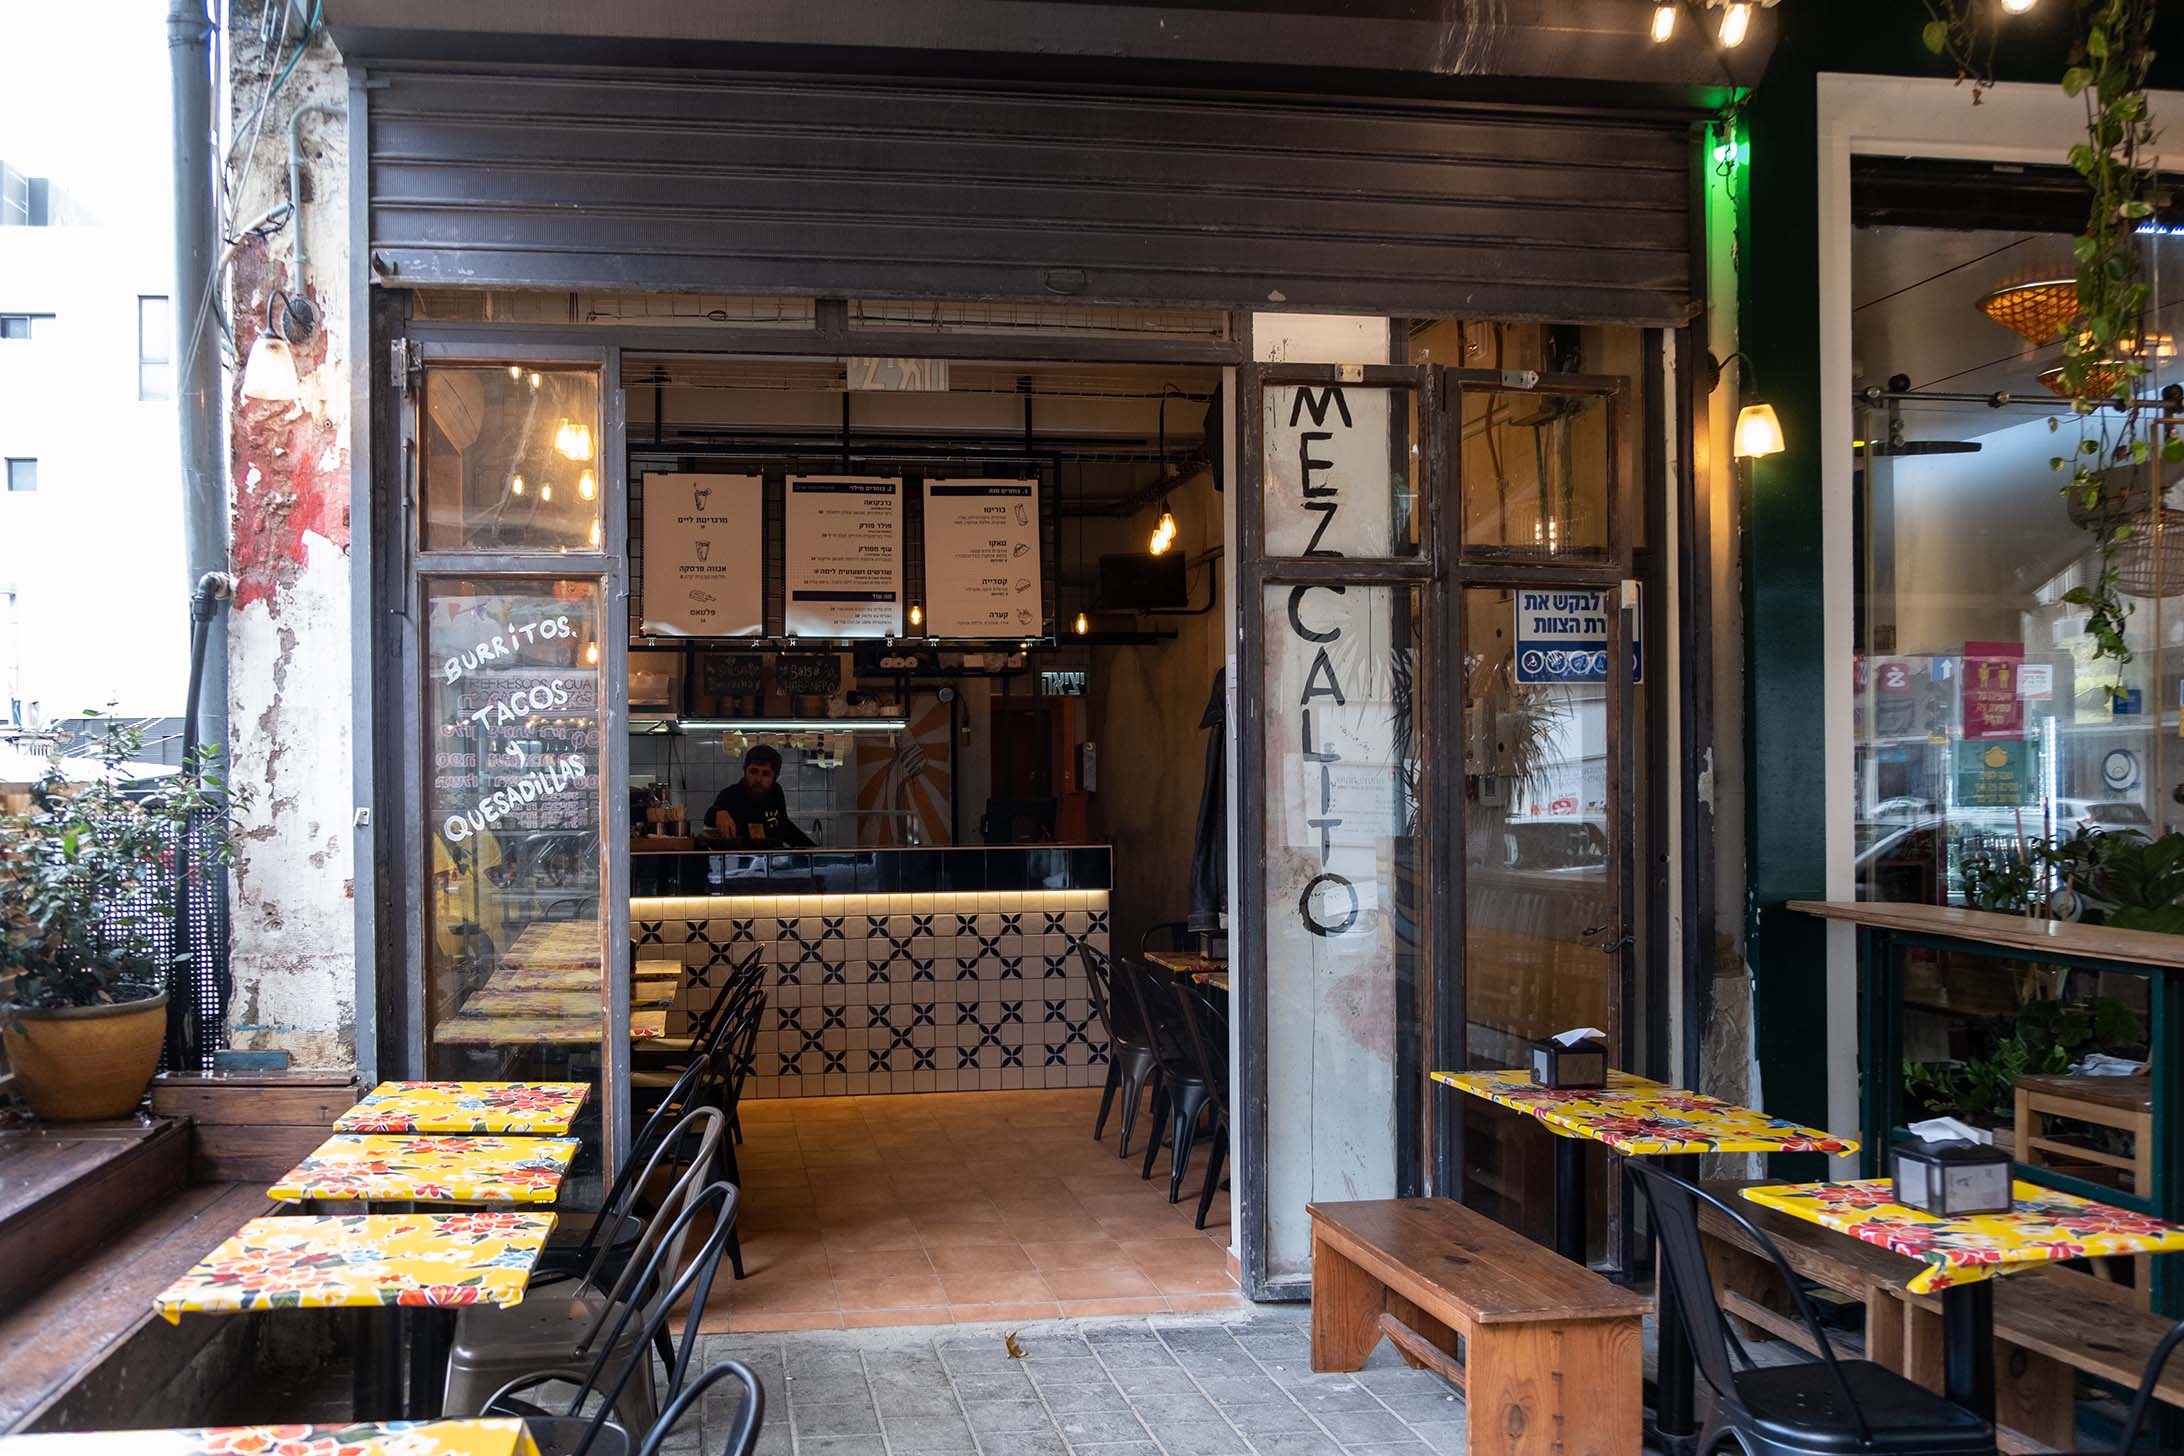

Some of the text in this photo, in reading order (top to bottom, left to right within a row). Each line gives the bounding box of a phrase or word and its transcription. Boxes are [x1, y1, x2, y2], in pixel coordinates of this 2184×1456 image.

[982, 578, 1008, 586] קסדייה
[1524, 594, 1549, 611] את
[1553, 592, 1600, 614] לבקש
[1534, 617, 1580, 634] הצוות
[1041, 671, 1085, 696] יציאה
[471, 679, 569, 731] TACOS
